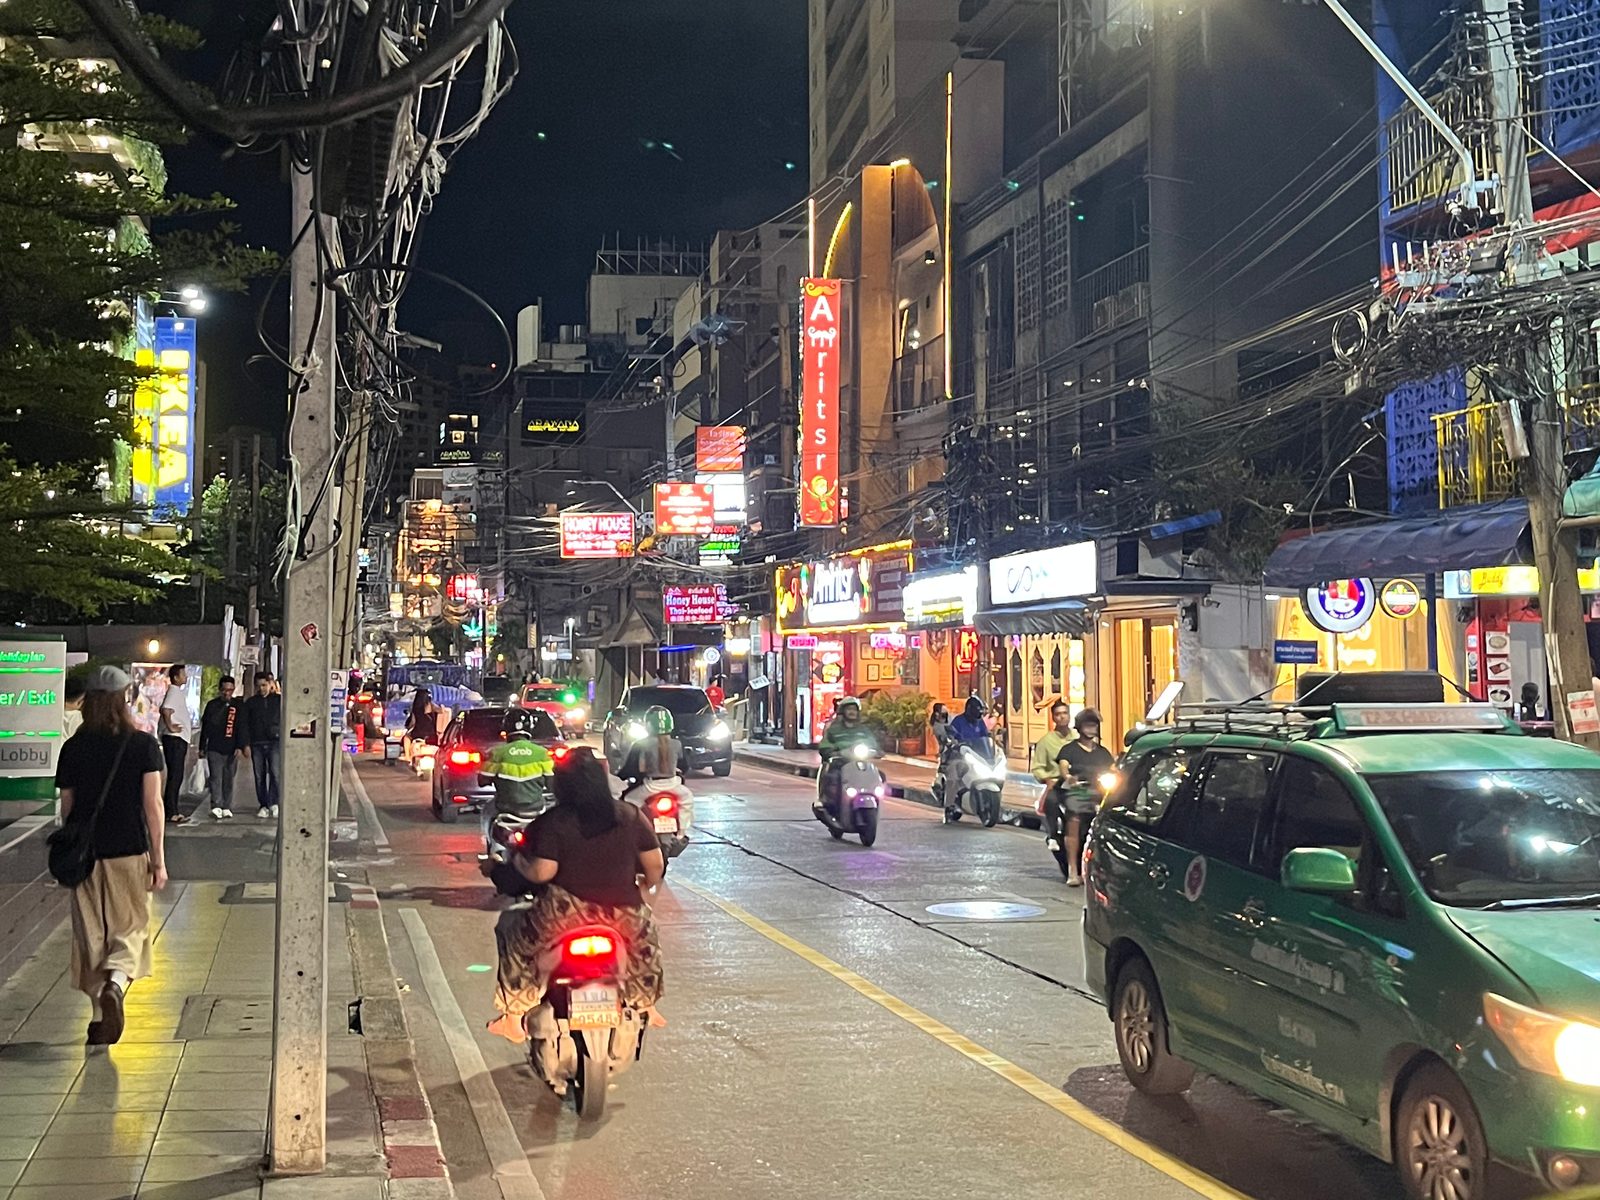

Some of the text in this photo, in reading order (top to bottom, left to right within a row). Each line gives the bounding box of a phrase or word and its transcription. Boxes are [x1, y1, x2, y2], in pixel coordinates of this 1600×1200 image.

[808, 295, 837, 470] Amritsr
[598, 516, 630, 531] HOUSE
[666, 594, 715, 606] Honey House
[28, 690, 56, 705] Exit
[225, 706, 237, 738] ISUZU
[1, 748, 48, 765] Lobby
[508, 746, 533, 756] Grab
